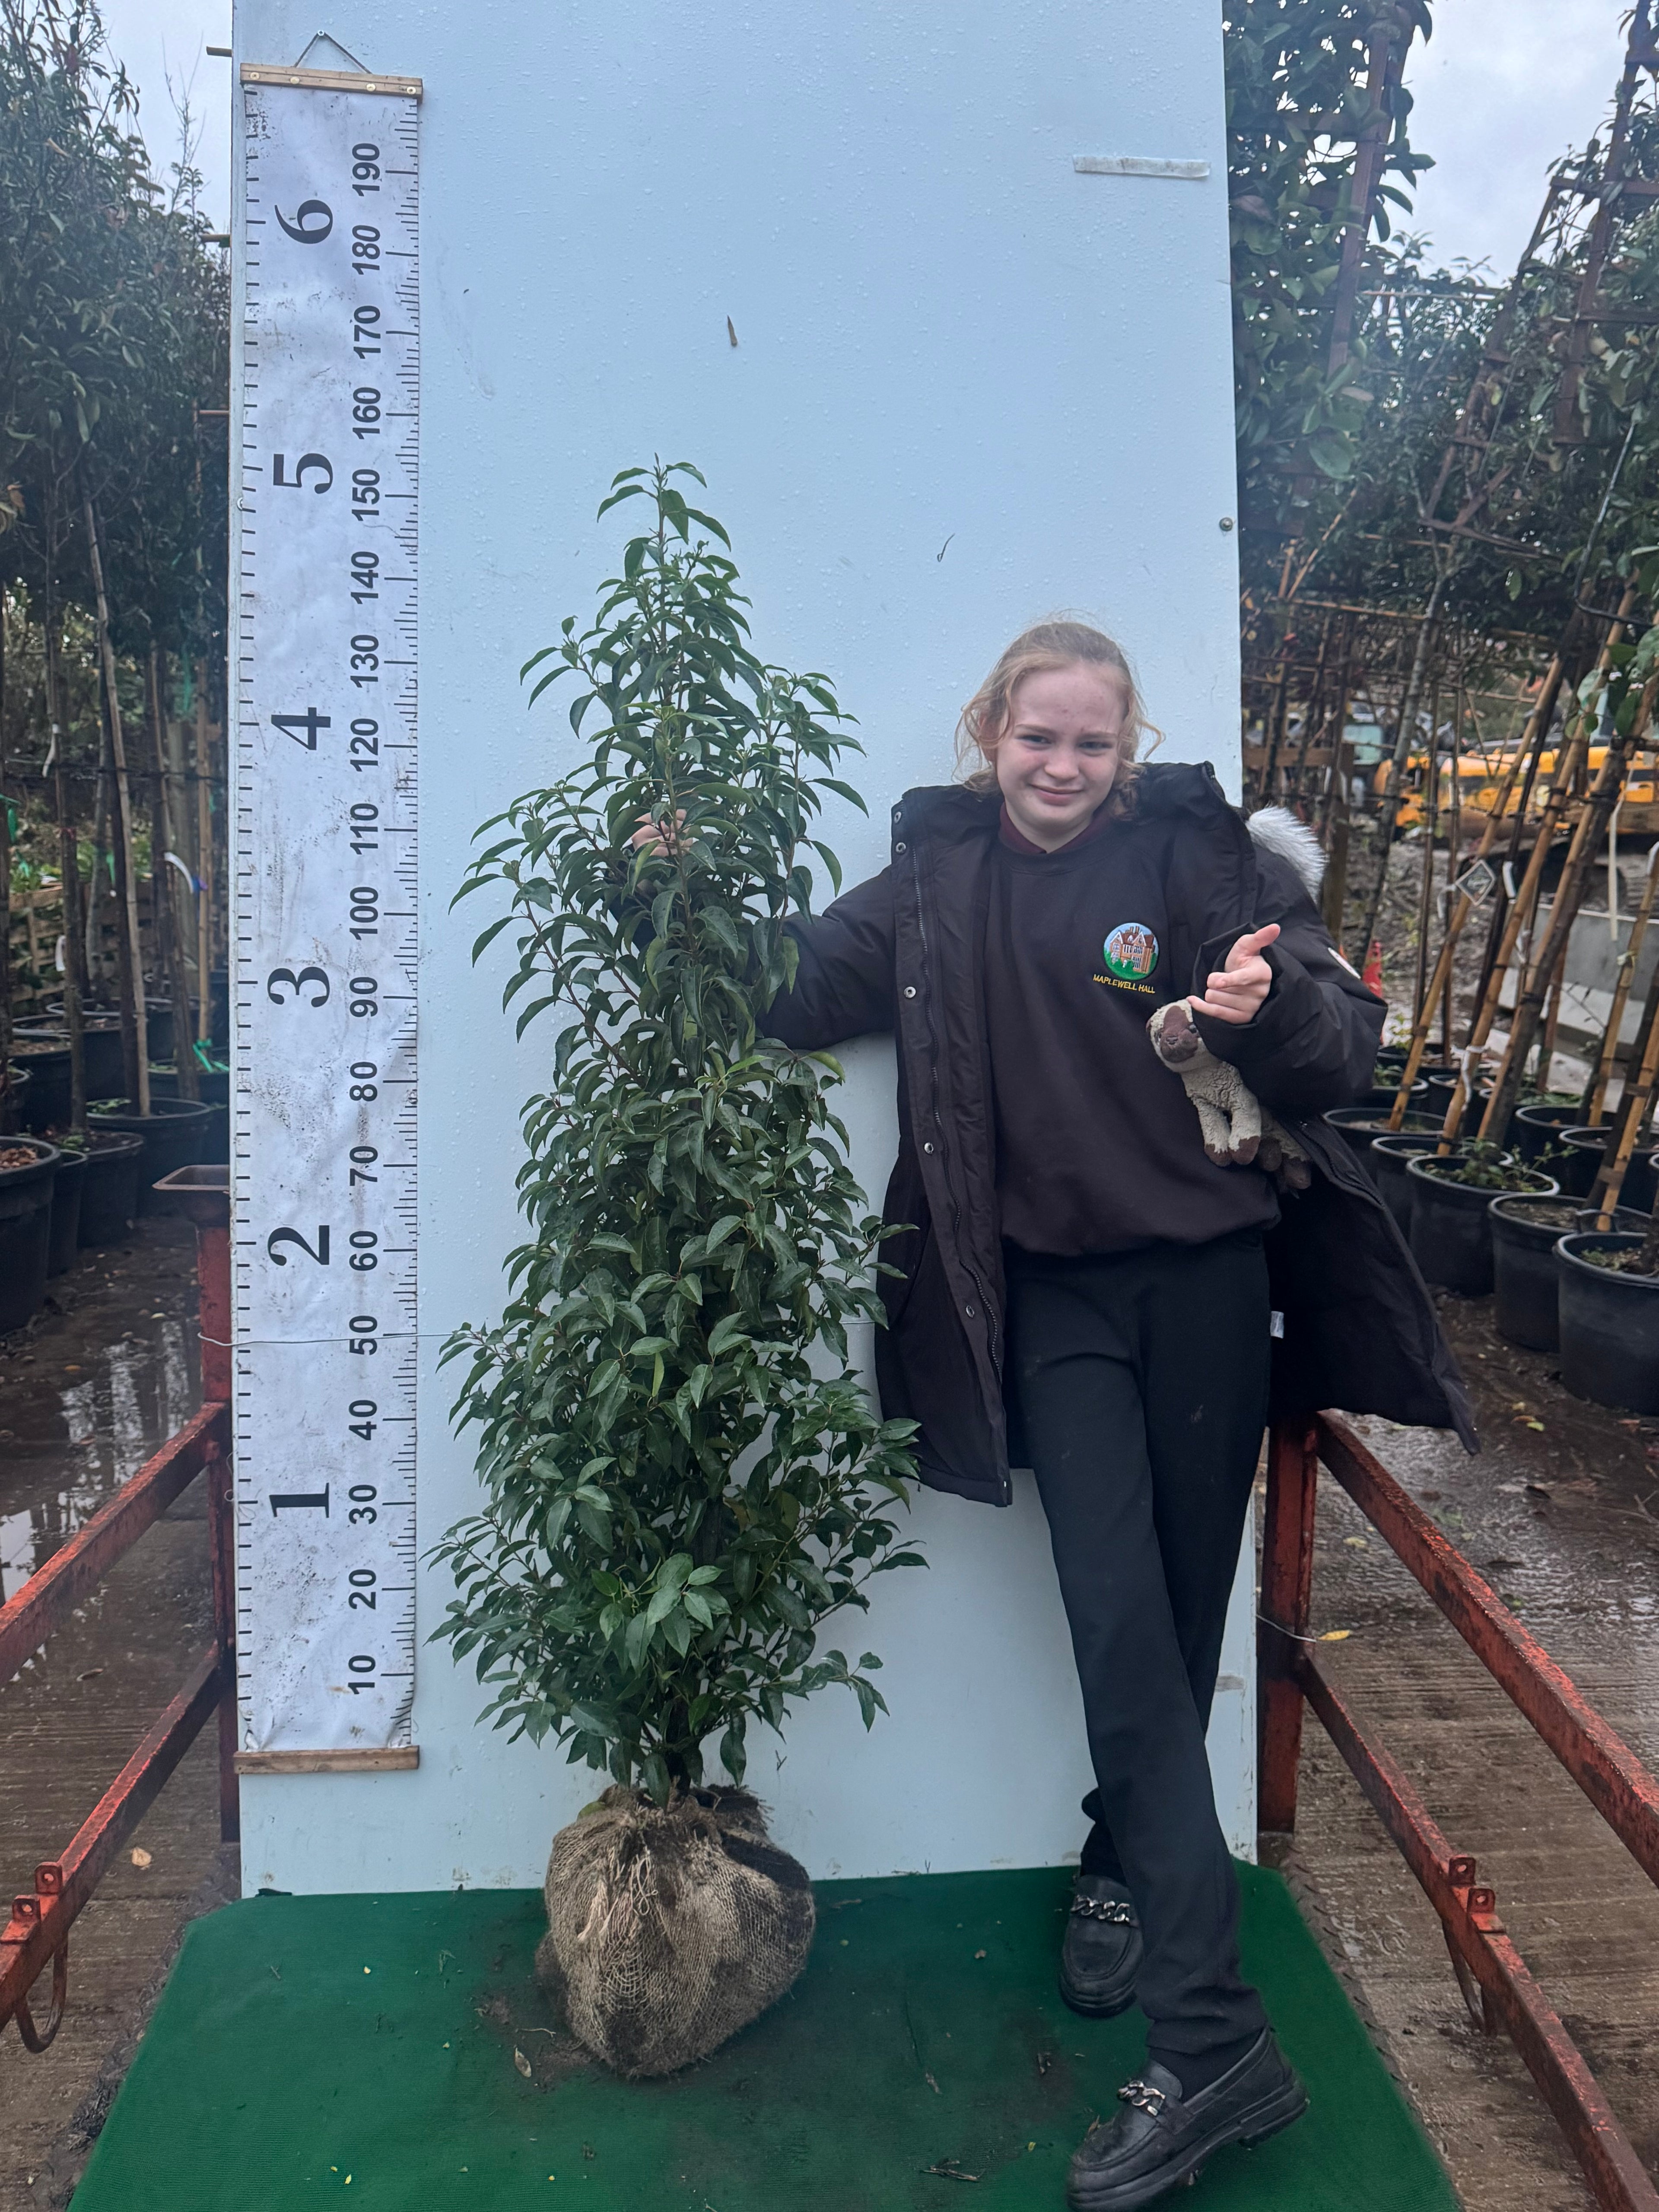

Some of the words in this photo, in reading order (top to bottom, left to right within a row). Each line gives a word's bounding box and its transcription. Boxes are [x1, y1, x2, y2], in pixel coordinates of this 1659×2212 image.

[353, 144, 380, 197] 190
[275, 200, 333, 244] 6
[352, 226, 380, 275] 180
[353, 306, 380, 359] 170
[353, 388, 380, 439] 160
[273, 453, 333, 494] 5
[352, 469, 379, 521] 150
[351, 552, 379, 604] 140
[350, 635, 379, 688] 130
[271, 707, 331, 751] 4
[350, 718, 378, 772] 120
[350, 804, 378, 855] 110
[350, 887, 378, 940] 100
[267, 966, 330, 1007] 3
[350, 977, 378, 1017] 90
[1093, 974, 1137, 991] MAPLEWELL
[1138, 984, 1156, 994] HALL
[350, 1062, 377, 1102] 80
[350, 1146, 378, 1186] 70
[267, 1225, 330, 1266] 2
[349, 1231, 378, 1271] 60
[349, 1316, 378, 1355] 50
[349, 1400, 377, 1440] 40
[269, 1482, 329, 1518] 1
[349, 1484, 377, 1525] 30
[348, 1569, 376, 1610] 20
[348, 1655, 375, 1694] 10
